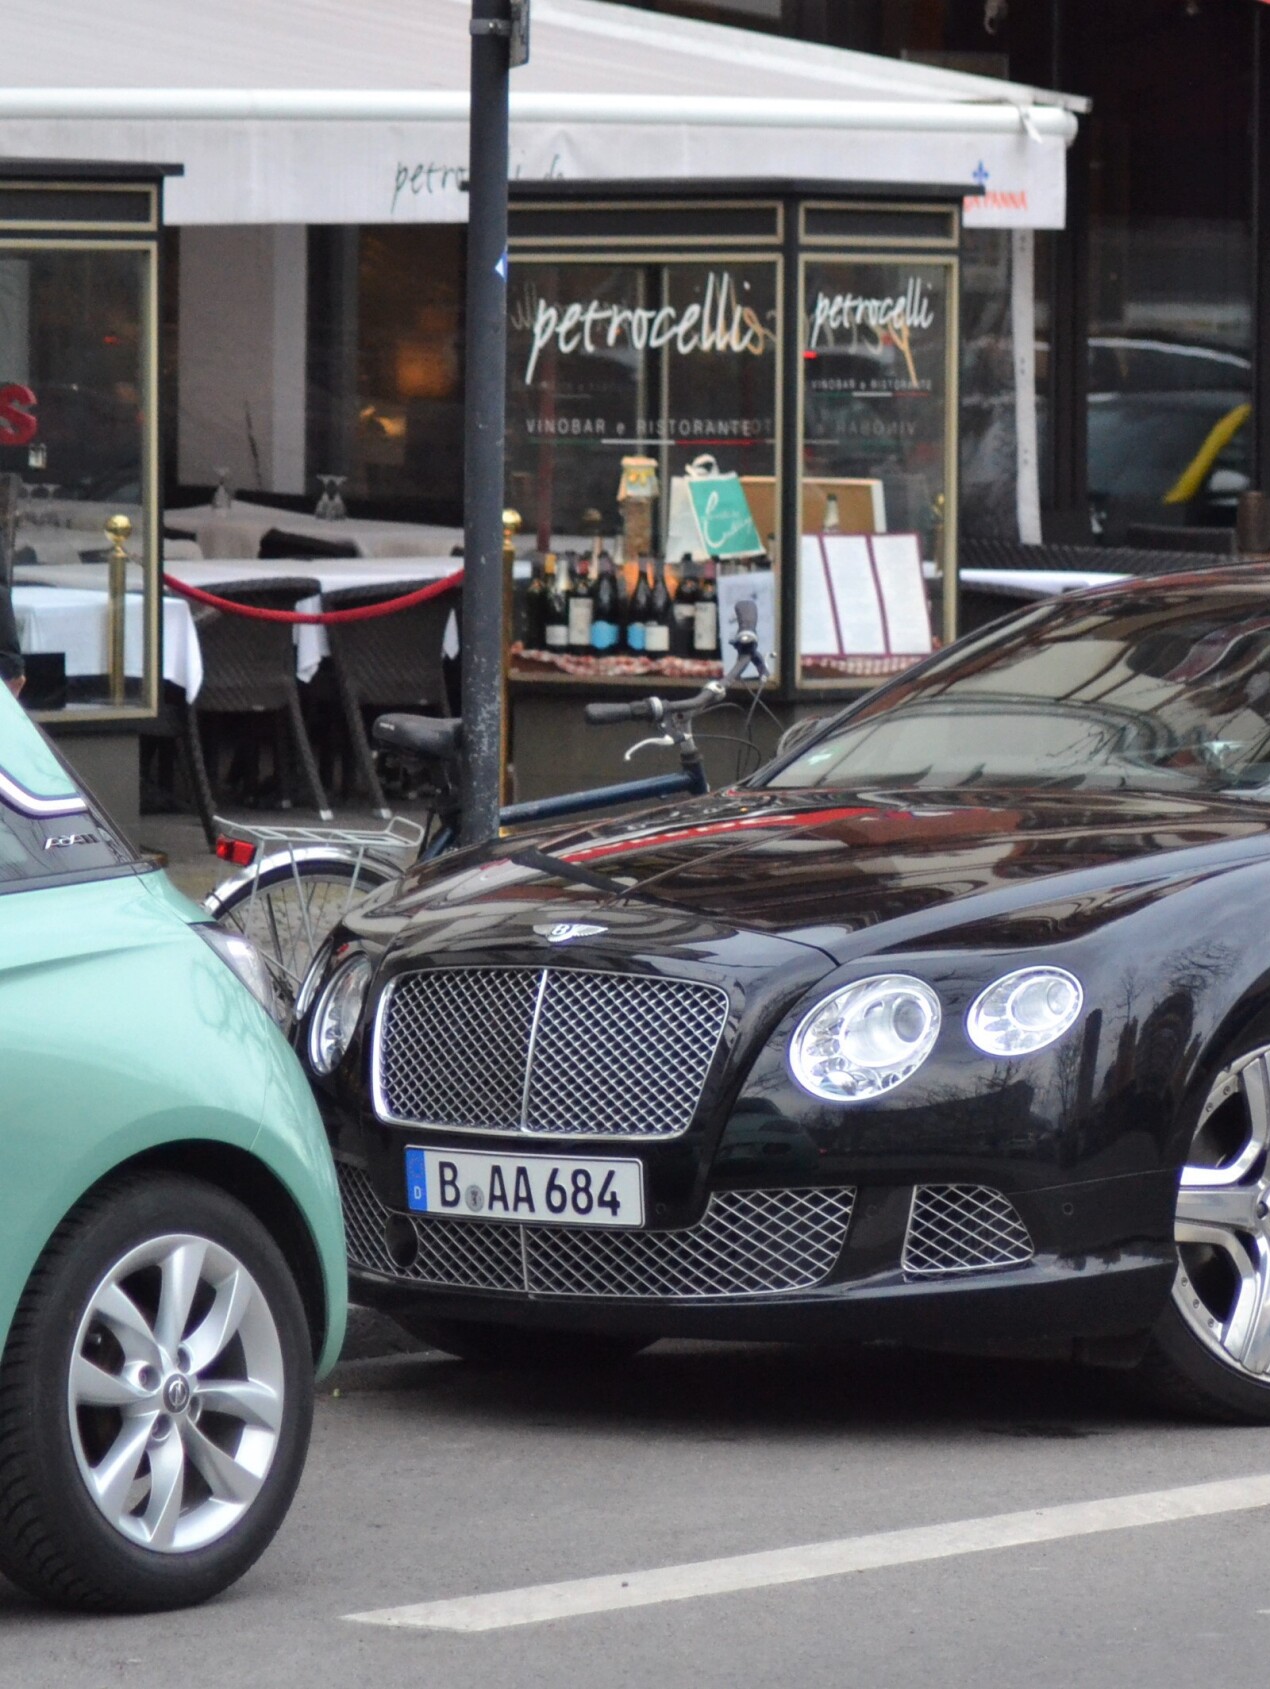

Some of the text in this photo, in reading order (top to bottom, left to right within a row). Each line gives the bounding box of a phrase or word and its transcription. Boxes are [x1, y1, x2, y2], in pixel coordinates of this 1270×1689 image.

[811, 277, 934, 349] petrocelli
[526, 419, 605, 435] VINOBAR
[636, 419, 752, 437] RISTORANTE
[414, 1186, 421, 1199] D
[439, 1161, 621, 1217] B AA 684
